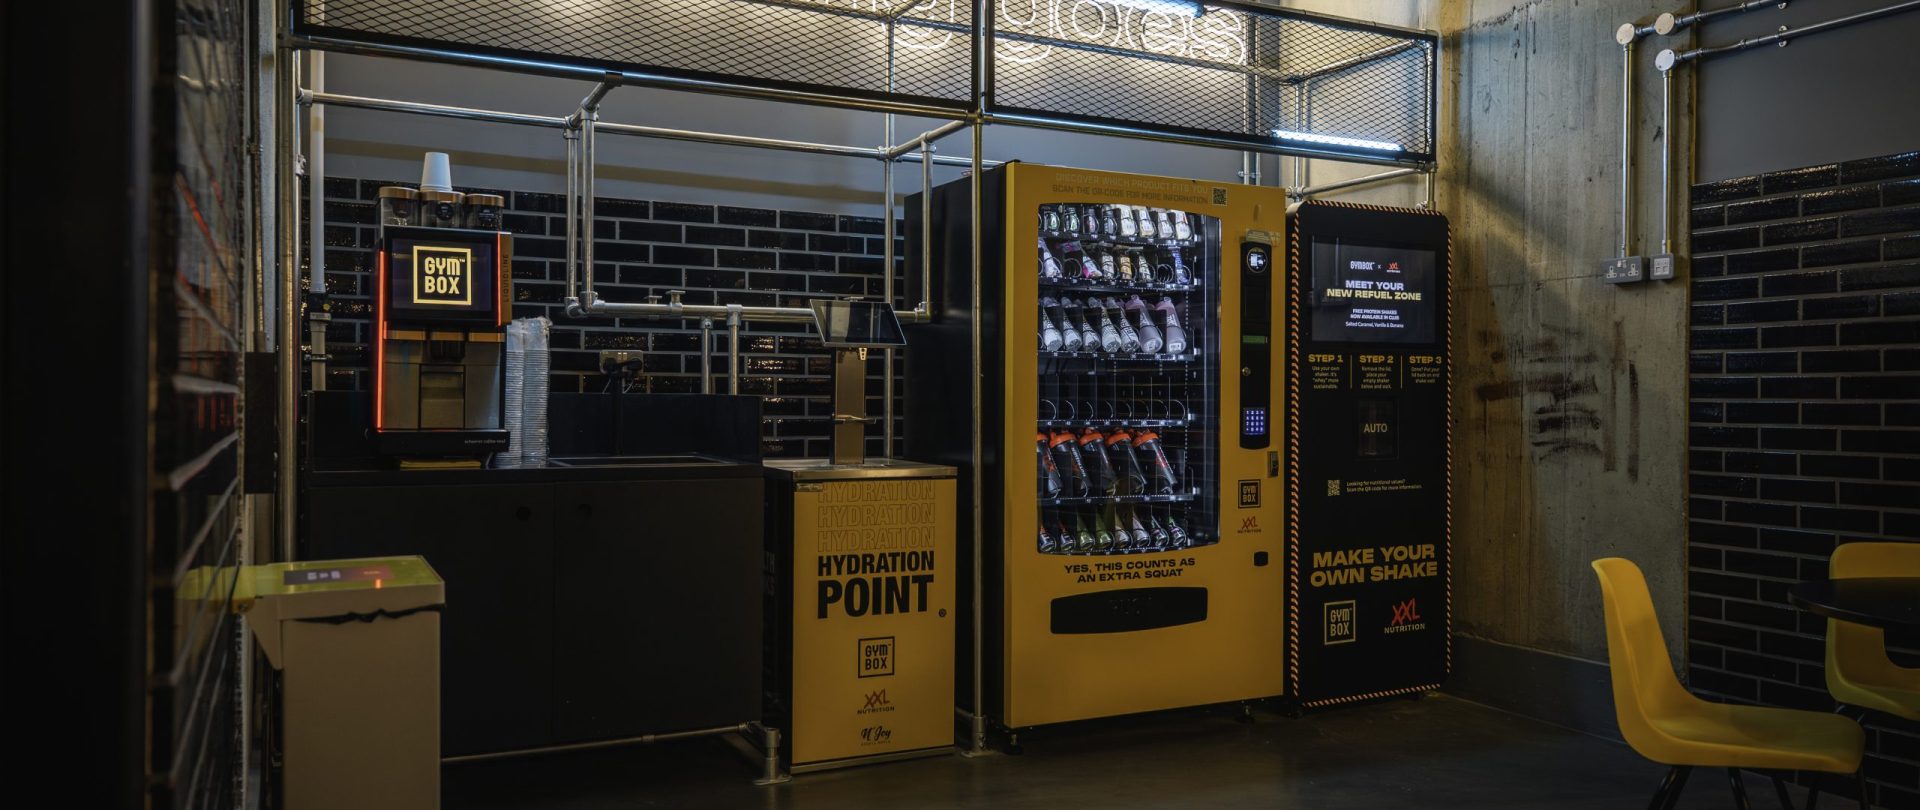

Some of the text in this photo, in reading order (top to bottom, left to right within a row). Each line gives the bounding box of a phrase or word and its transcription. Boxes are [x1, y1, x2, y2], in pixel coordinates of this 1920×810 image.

[1052, 184, 1074, 194] SCAN
[1076, 186, 1090, 195] THE
[1126, 190, 1140, 198] FOR
[424, 276, 460, 294] BOX
[1346, 280, 1404, 291] MEET YOUR
[1326, 288, 1422, 300] NEW REFUEL ZONE
[1308, 354, 1344, 363] STEP 1
[1359, 355, 1385, 363] STEP
[1409, 356, 1434, 364] STEP
[1364, 423, 1387, 433] AUTO
[818, 480, 936, 503] HYDRATION
[1243, 494, 1256, 502] BOX
[818, 503, 936, 528] HYDRATION
[1242, 516, 1258, 530] XXL
[817, 526, 936, 552] HYDRATION
[818, 550, 934, 576] HYDRATION
[1313, 544, 1435, 568] MAKE YOUR
[1064, 558, 1196, 574] YES, THIS COUNTS AS
[1077, 568, 1183, 583] AN EXTRA SQUAT
[1310, 561, 1438, 588] OWN SHAKE
[817, 574, 934, 619] POINT
[1392, 598, 1420, 626] XXL
[1330, 622, 1350, 636] BOX
[1384, 623, 1425, 634] NUTRITION
[865, 657, 887, 670] BOX
[864, 688, 890, 708] XXL
[857, 706, 895, 714] NUTRITION
